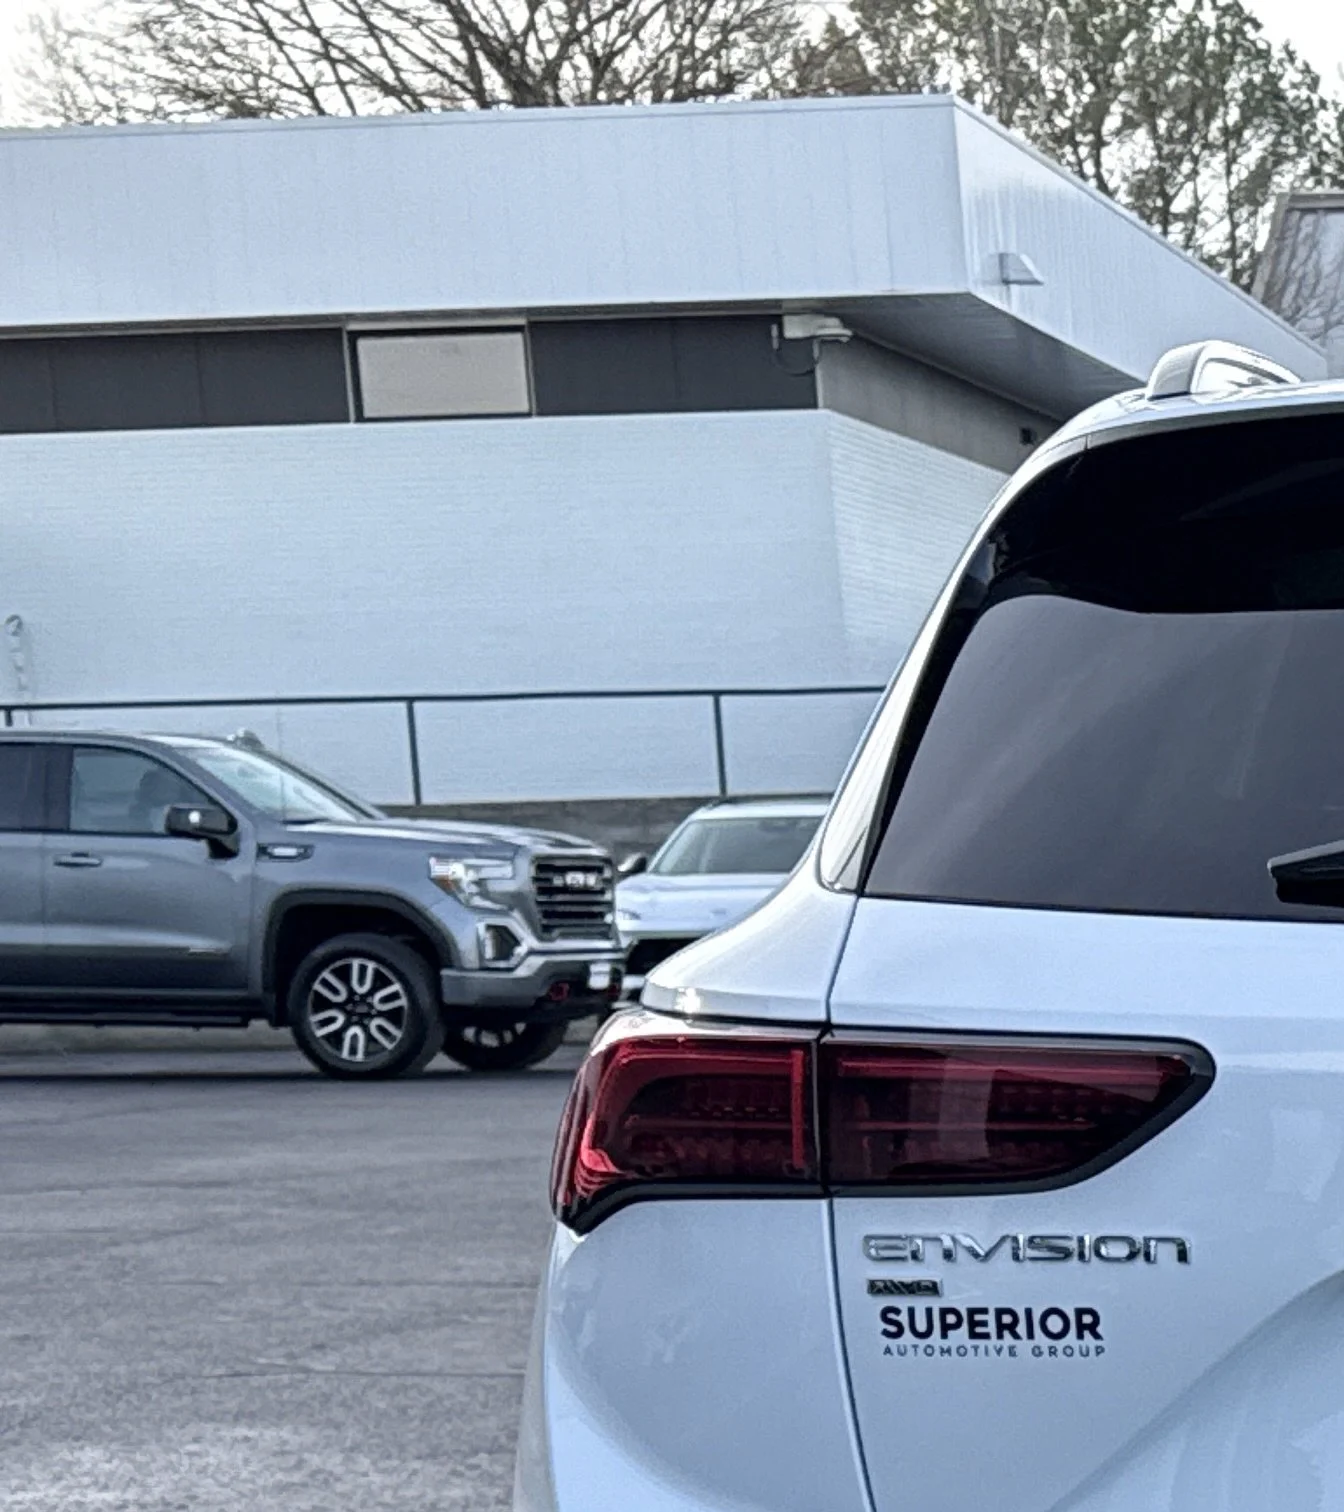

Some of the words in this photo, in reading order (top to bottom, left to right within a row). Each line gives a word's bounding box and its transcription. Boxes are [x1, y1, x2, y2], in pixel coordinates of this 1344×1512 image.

[862, 1233, 1192, 1264] ENVISION
[879, 1306, 1104, 1340] SUPERIOR
[883, 1344, 1018, 1358] AUTOMOTIVE
[1031, 1344, 1106, 1358] GROUP
